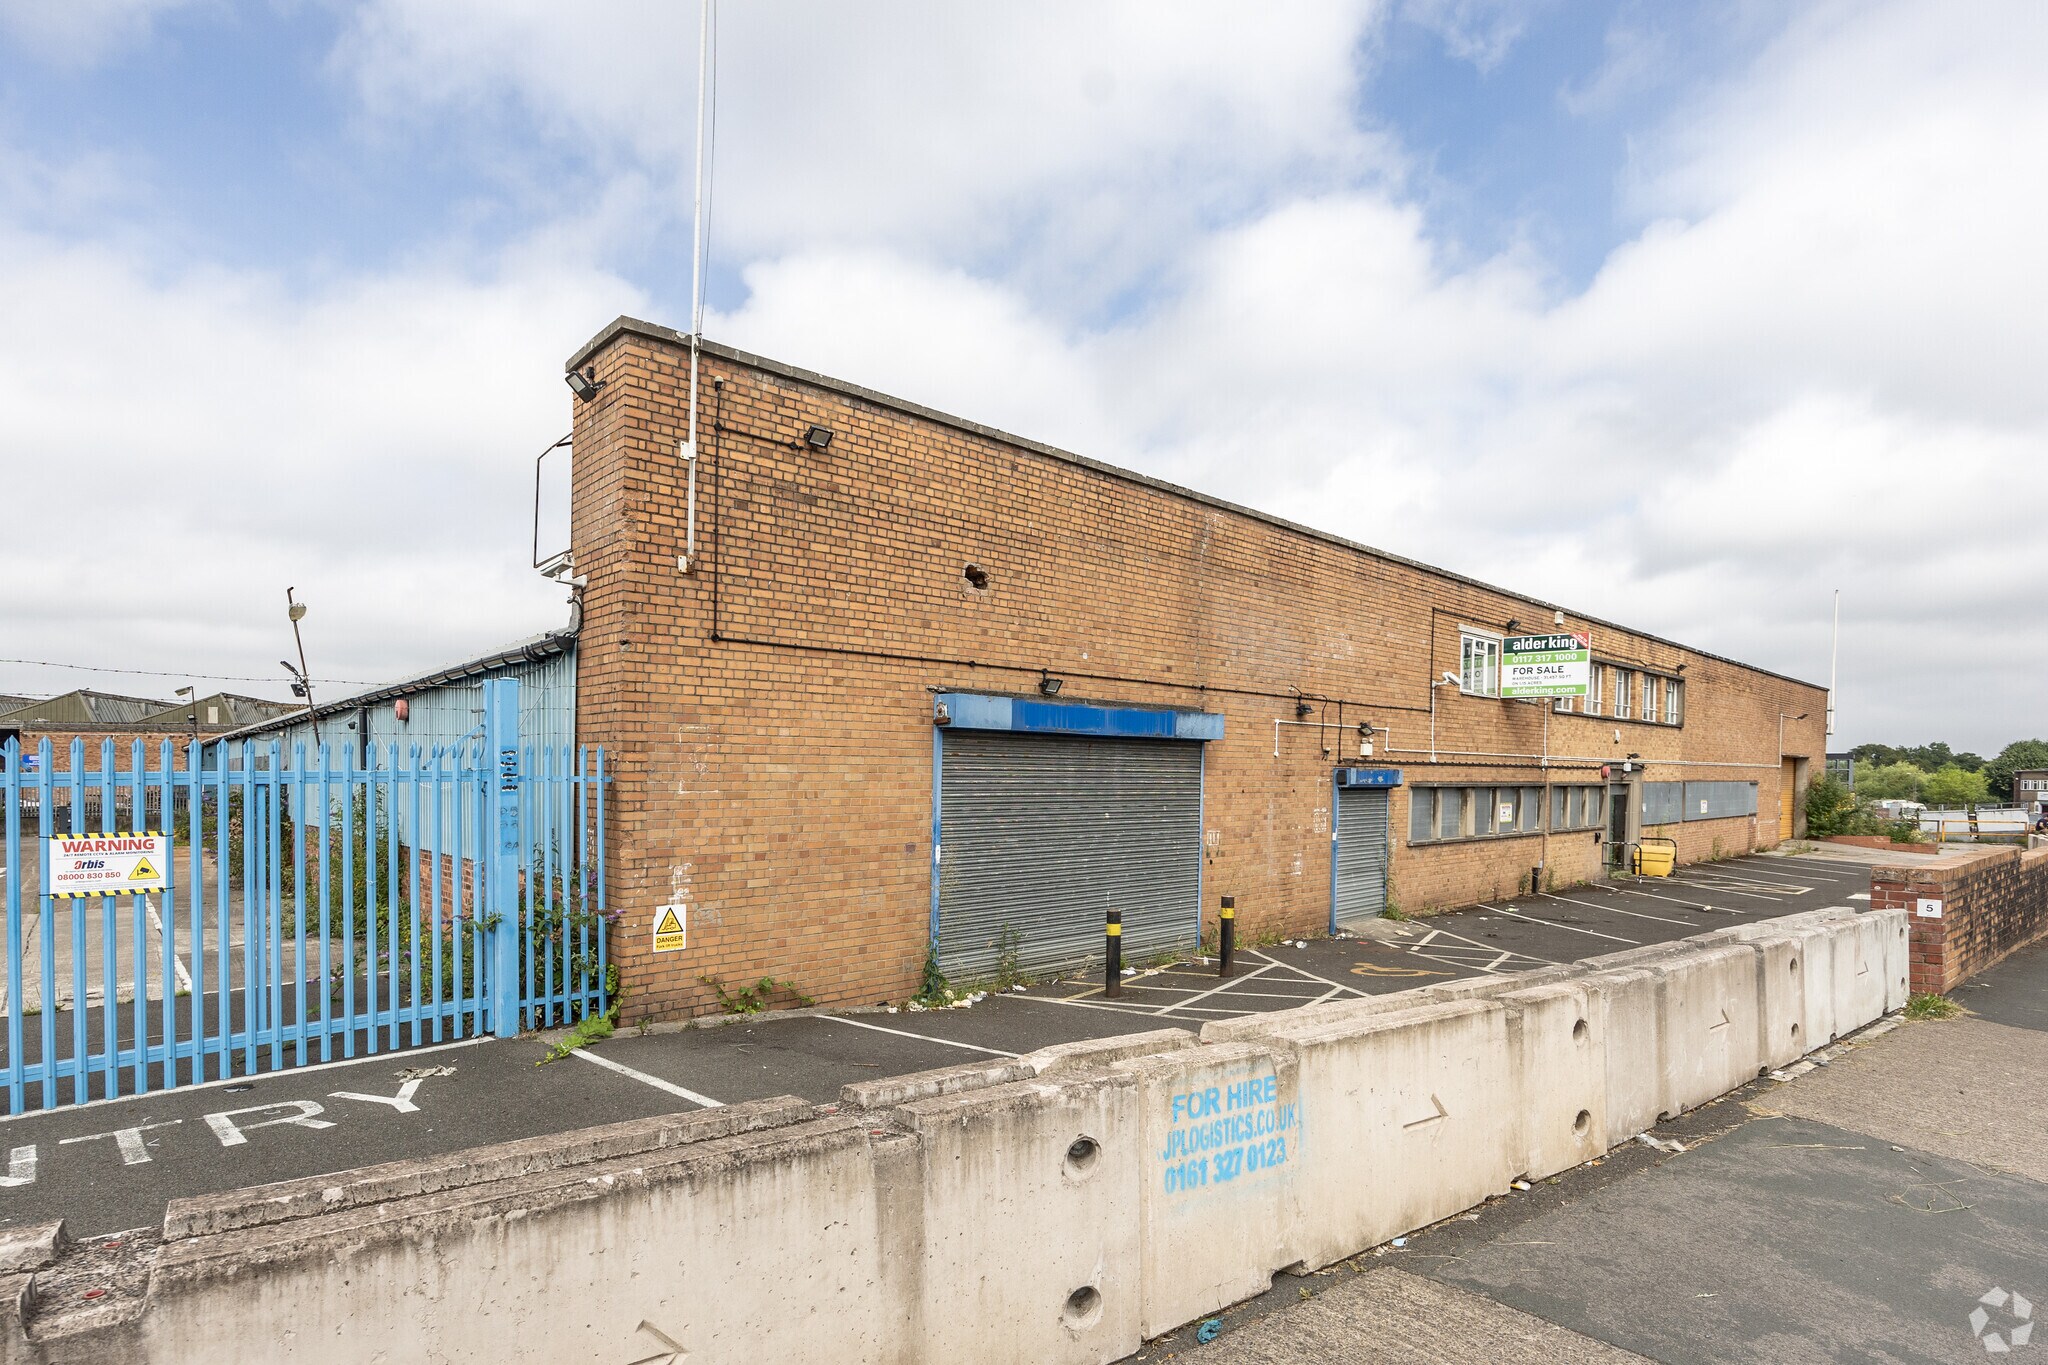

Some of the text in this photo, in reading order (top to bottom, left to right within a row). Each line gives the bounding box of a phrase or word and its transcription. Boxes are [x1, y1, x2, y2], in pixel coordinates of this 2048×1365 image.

[1512, 638, 1547, 651] alder
[1548, 636, 1578, 650] king
[1512, 653, 1577, 663] 0117 317 1000
[1512, 666, 1564, 675] FOR SALE
[1511, 686, 1577, 695] alderking.com
[61, 838, 155, 853] WARNING
[57, 873, 85, 881] 08000
[1926, 904, 1934, 912] 5
[656, 935, 683, 944] DANGER
[1172, 1075, 1277, 1123] FOR HIRE
[1163, 1102, 1297, 1161] JPLOGISTICS.CO.UK
[1164, 1136, 1287, 1195] 0161 327 0123
